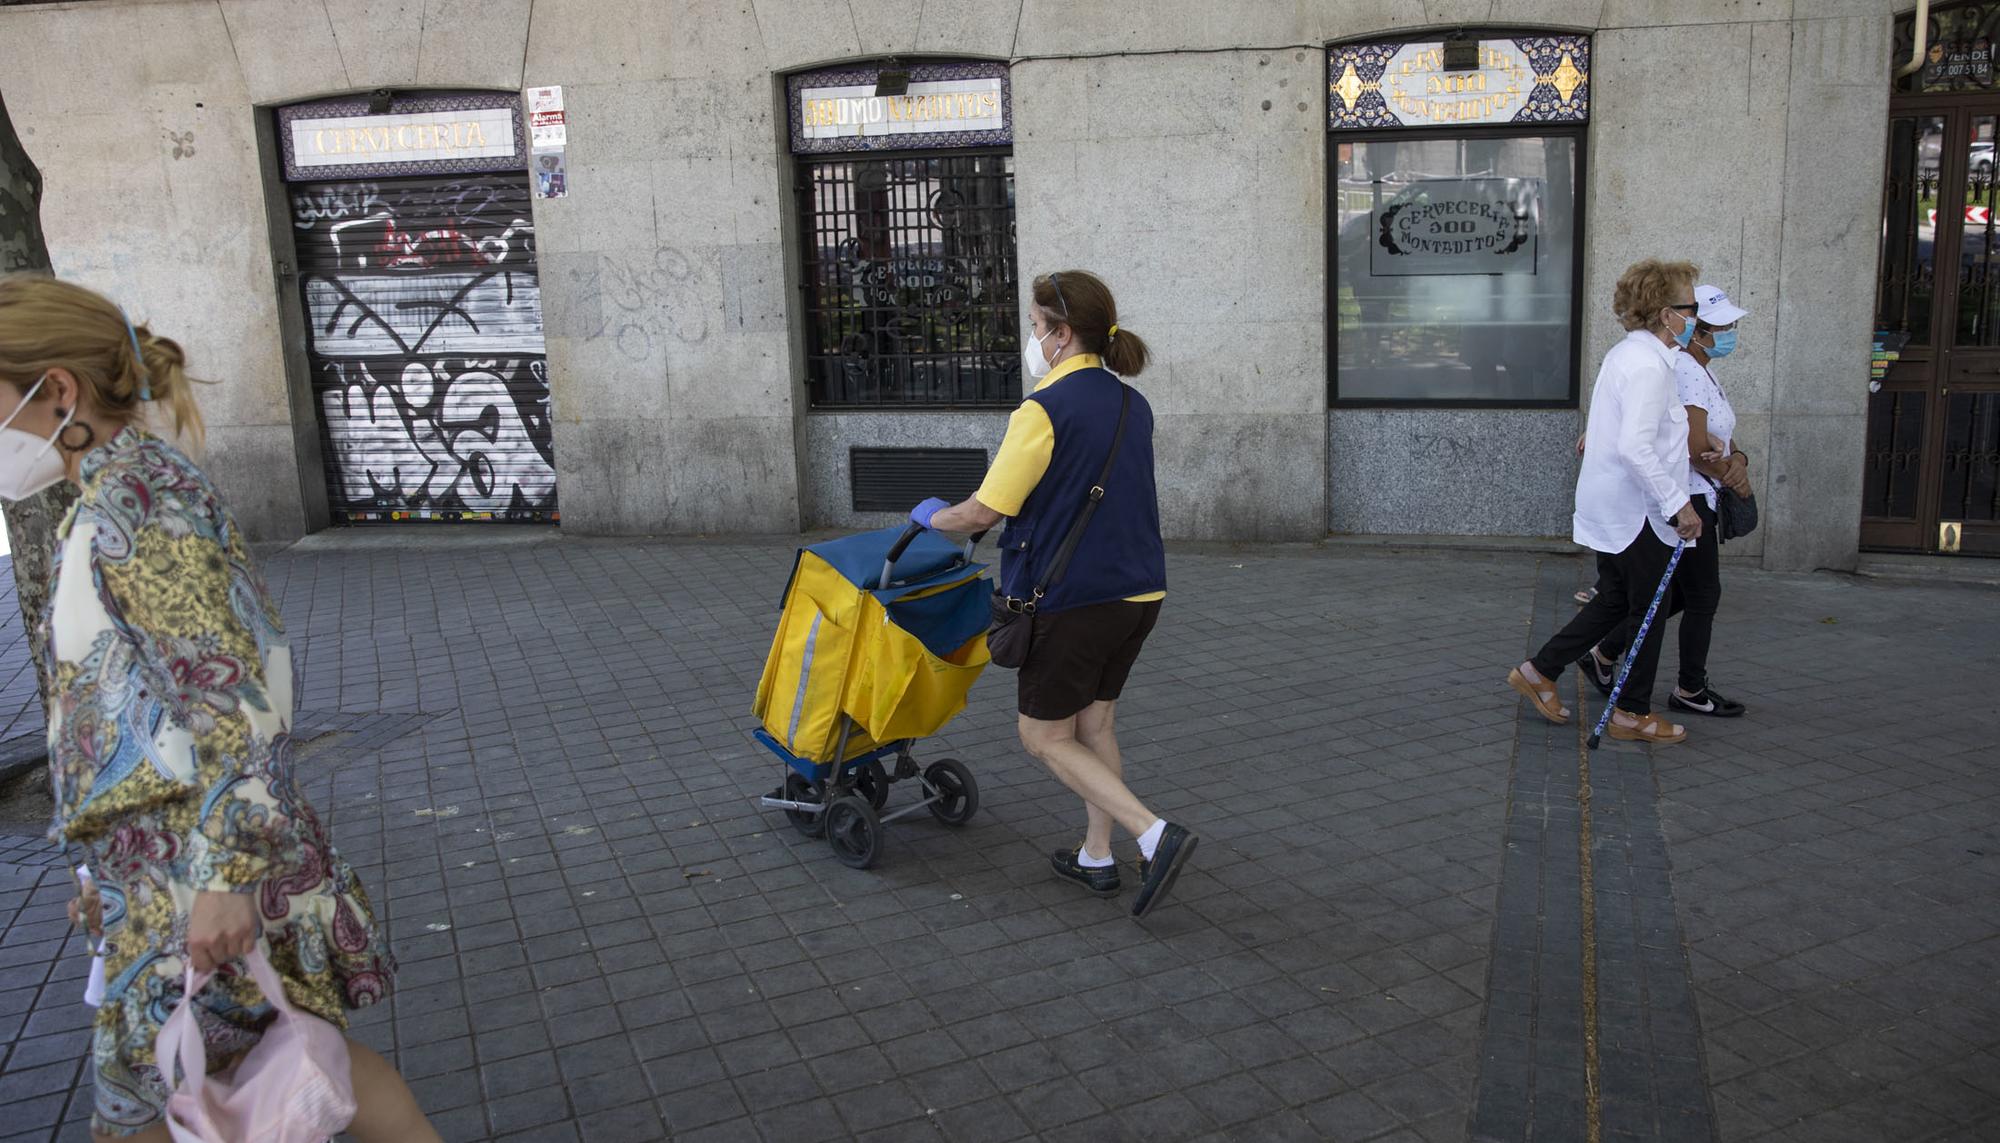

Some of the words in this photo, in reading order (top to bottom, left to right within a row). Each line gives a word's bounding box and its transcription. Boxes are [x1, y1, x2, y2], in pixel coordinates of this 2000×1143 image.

[532, 113, 563, 122] Alarma
[315, 121, 487, 158] CERVECERIA
[1399, 200, 1510, 230] CERVECERIA
[1401, 230, 1506, 254] MONTADITOS
